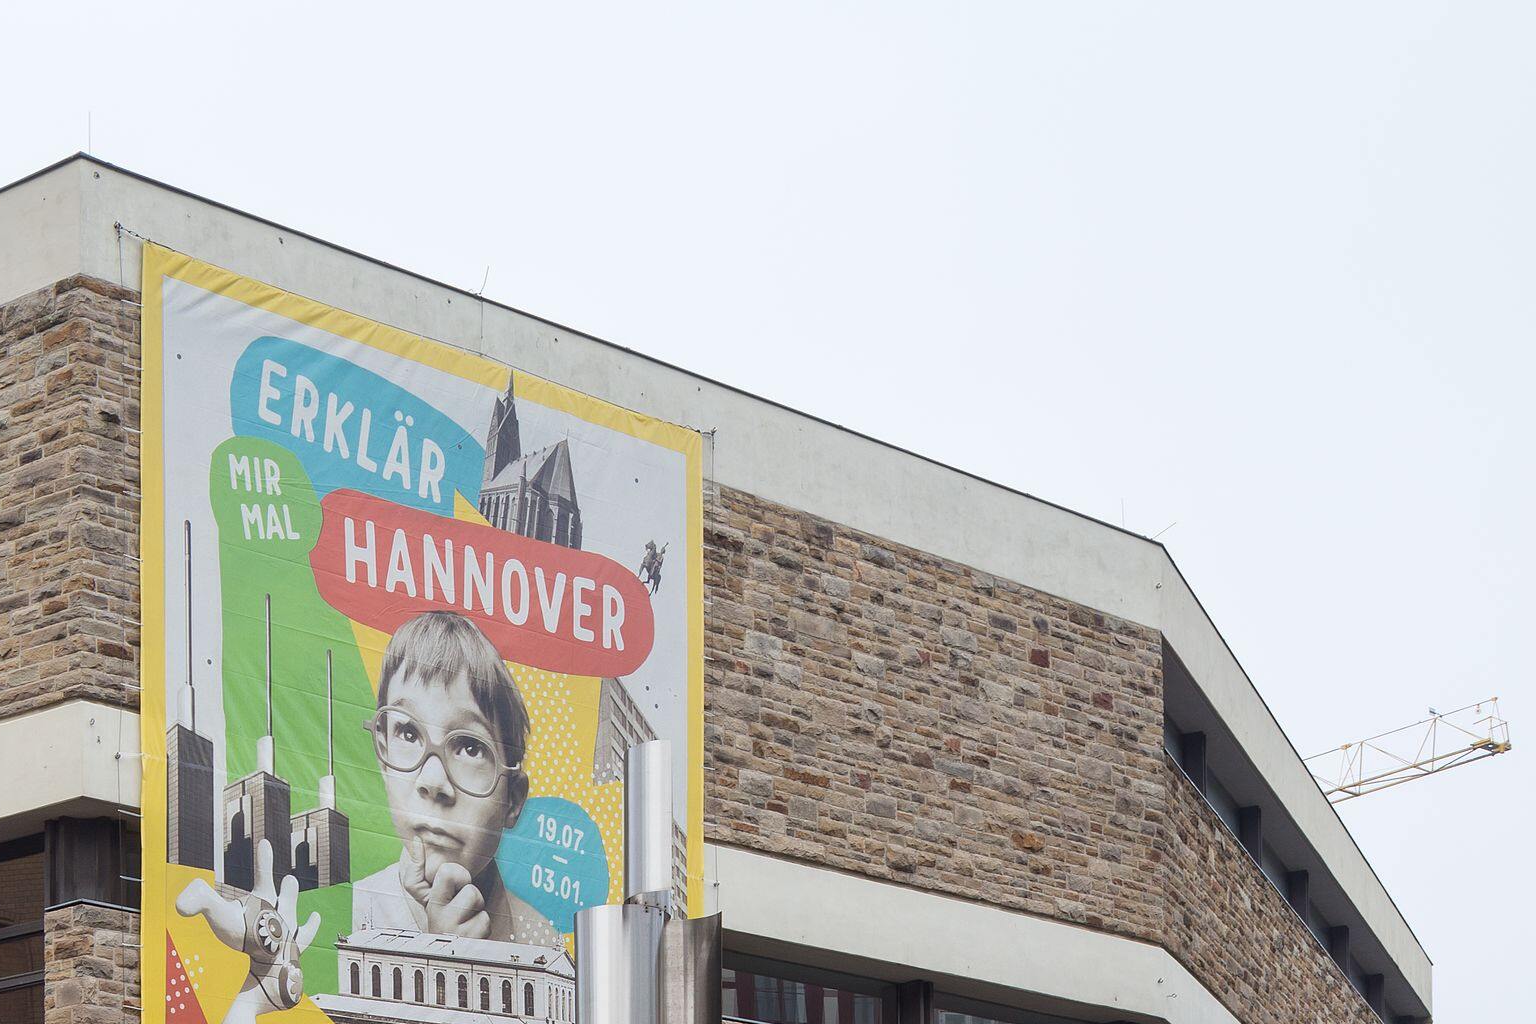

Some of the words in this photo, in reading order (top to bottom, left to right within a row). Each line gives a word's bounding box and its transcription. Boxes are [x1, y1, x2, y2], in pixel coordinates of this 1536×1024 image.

[257, 359, 446, 504] ERKLÄR
[228, 453, 282, 496] MIR
[240, 503, 300, 541] MAL
[343, 516, 626, 652] HANNOVER
[537, 813, 585, 855] 19.07.
[531, 864, 584, 906] 03.01.
